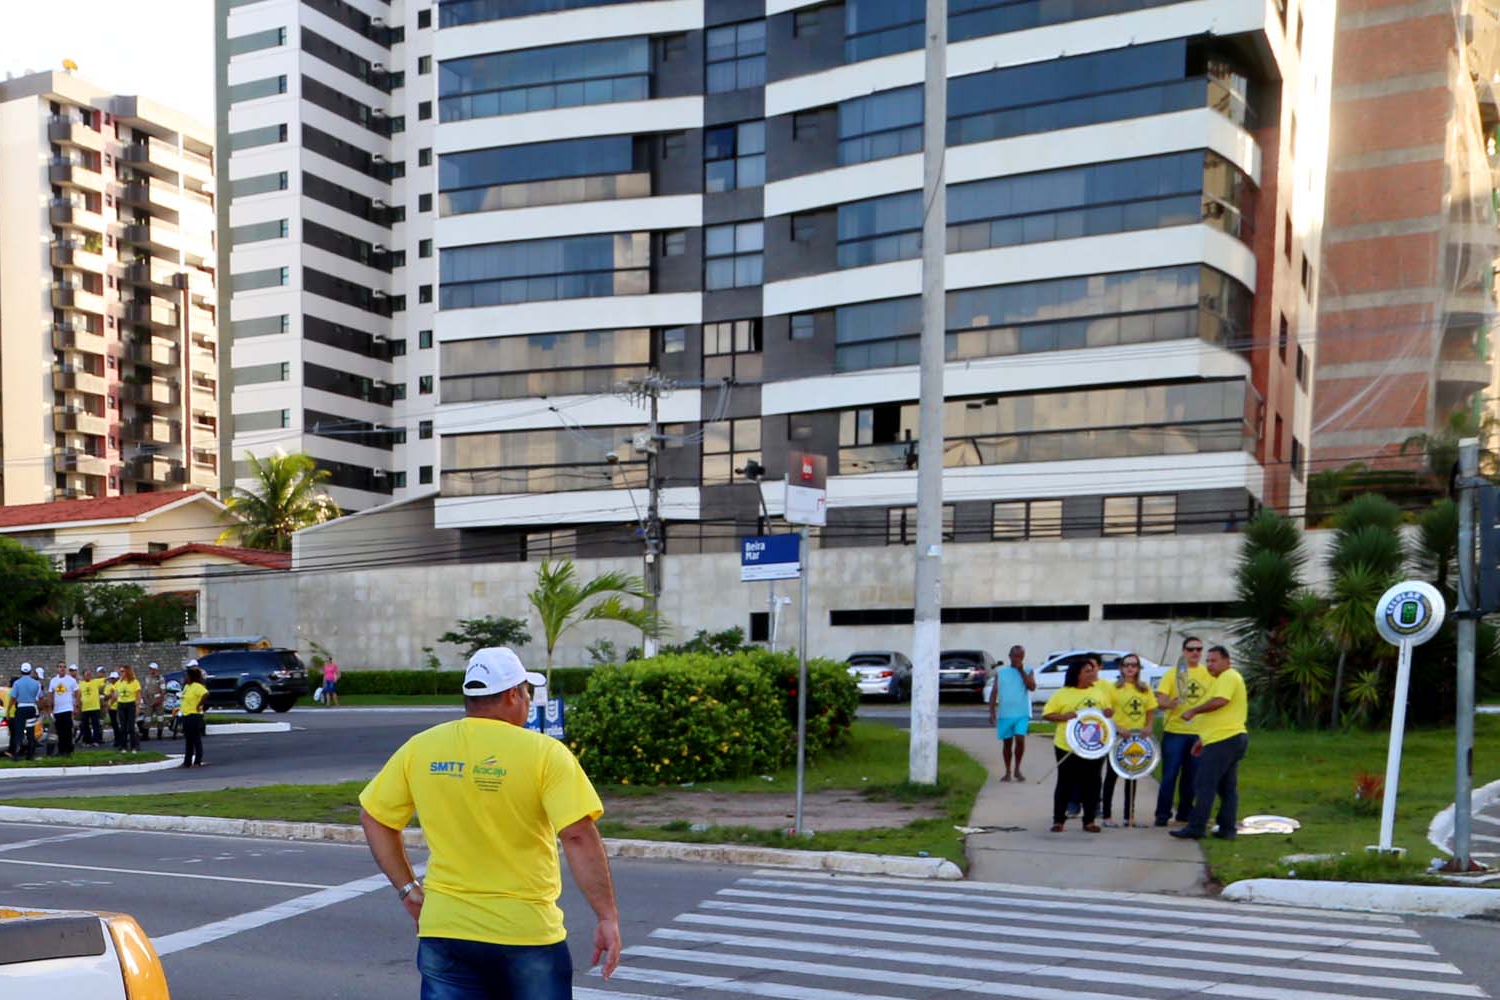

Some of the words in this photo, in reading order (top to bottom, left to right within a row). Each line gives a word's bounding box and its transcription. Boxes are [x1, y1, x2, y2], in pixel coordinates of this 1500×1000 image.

[745, 542, 766, 551] Beira
[745, 551, 760, 560] Mar
[430, 761, 466, 772] SMTT
